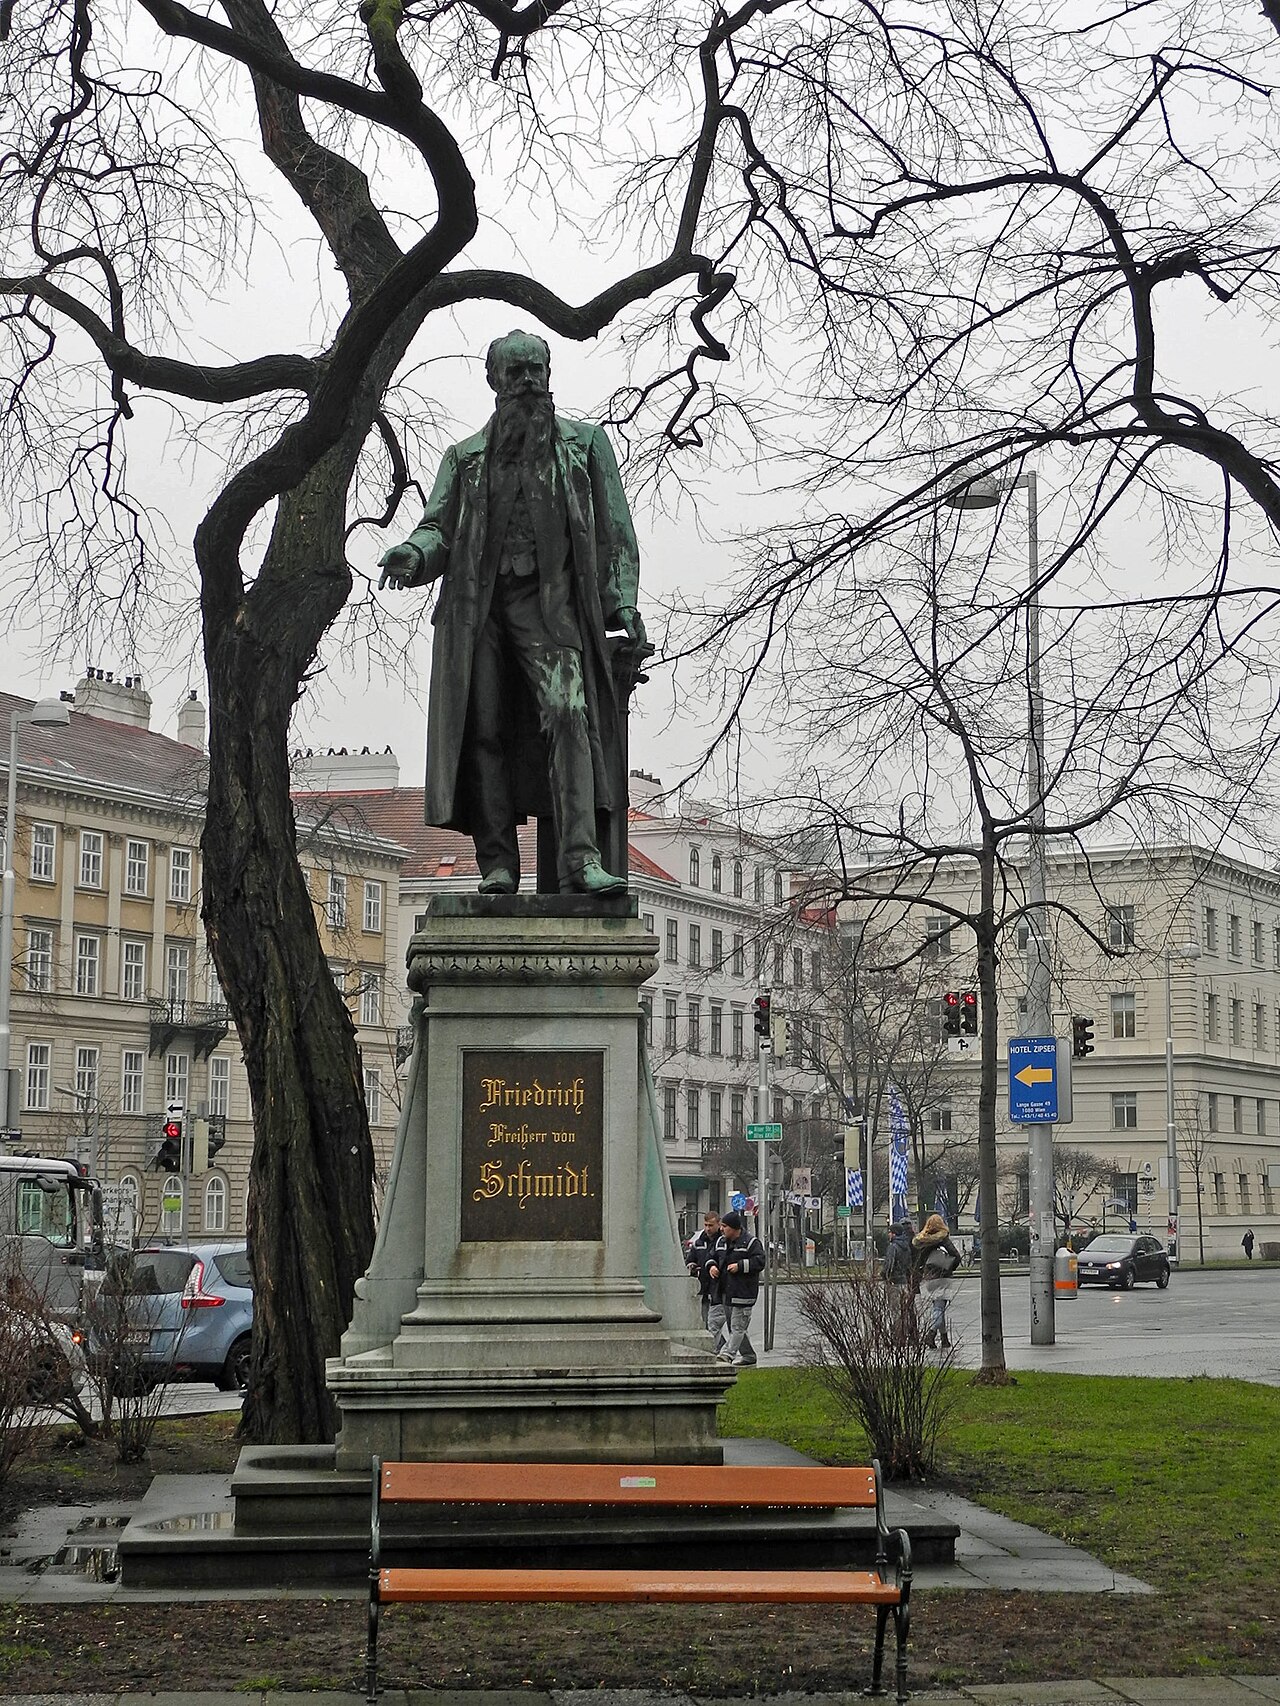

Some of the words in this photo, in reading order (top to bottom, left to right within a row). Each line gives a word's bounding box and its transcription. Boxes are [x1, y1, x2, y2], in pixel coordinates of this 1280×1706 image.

[1010, 1046, 1032, 1054] HOTEL
[1033, 1045, 1056, 1053] ZIPSER
[479, 1077, 585, 1115] Friedrich
[486, 1123, 548, 1149] Freiherr
[552, 1128, 576, 1143] von
[472, 1159, 595, 1209] Schmidt.
